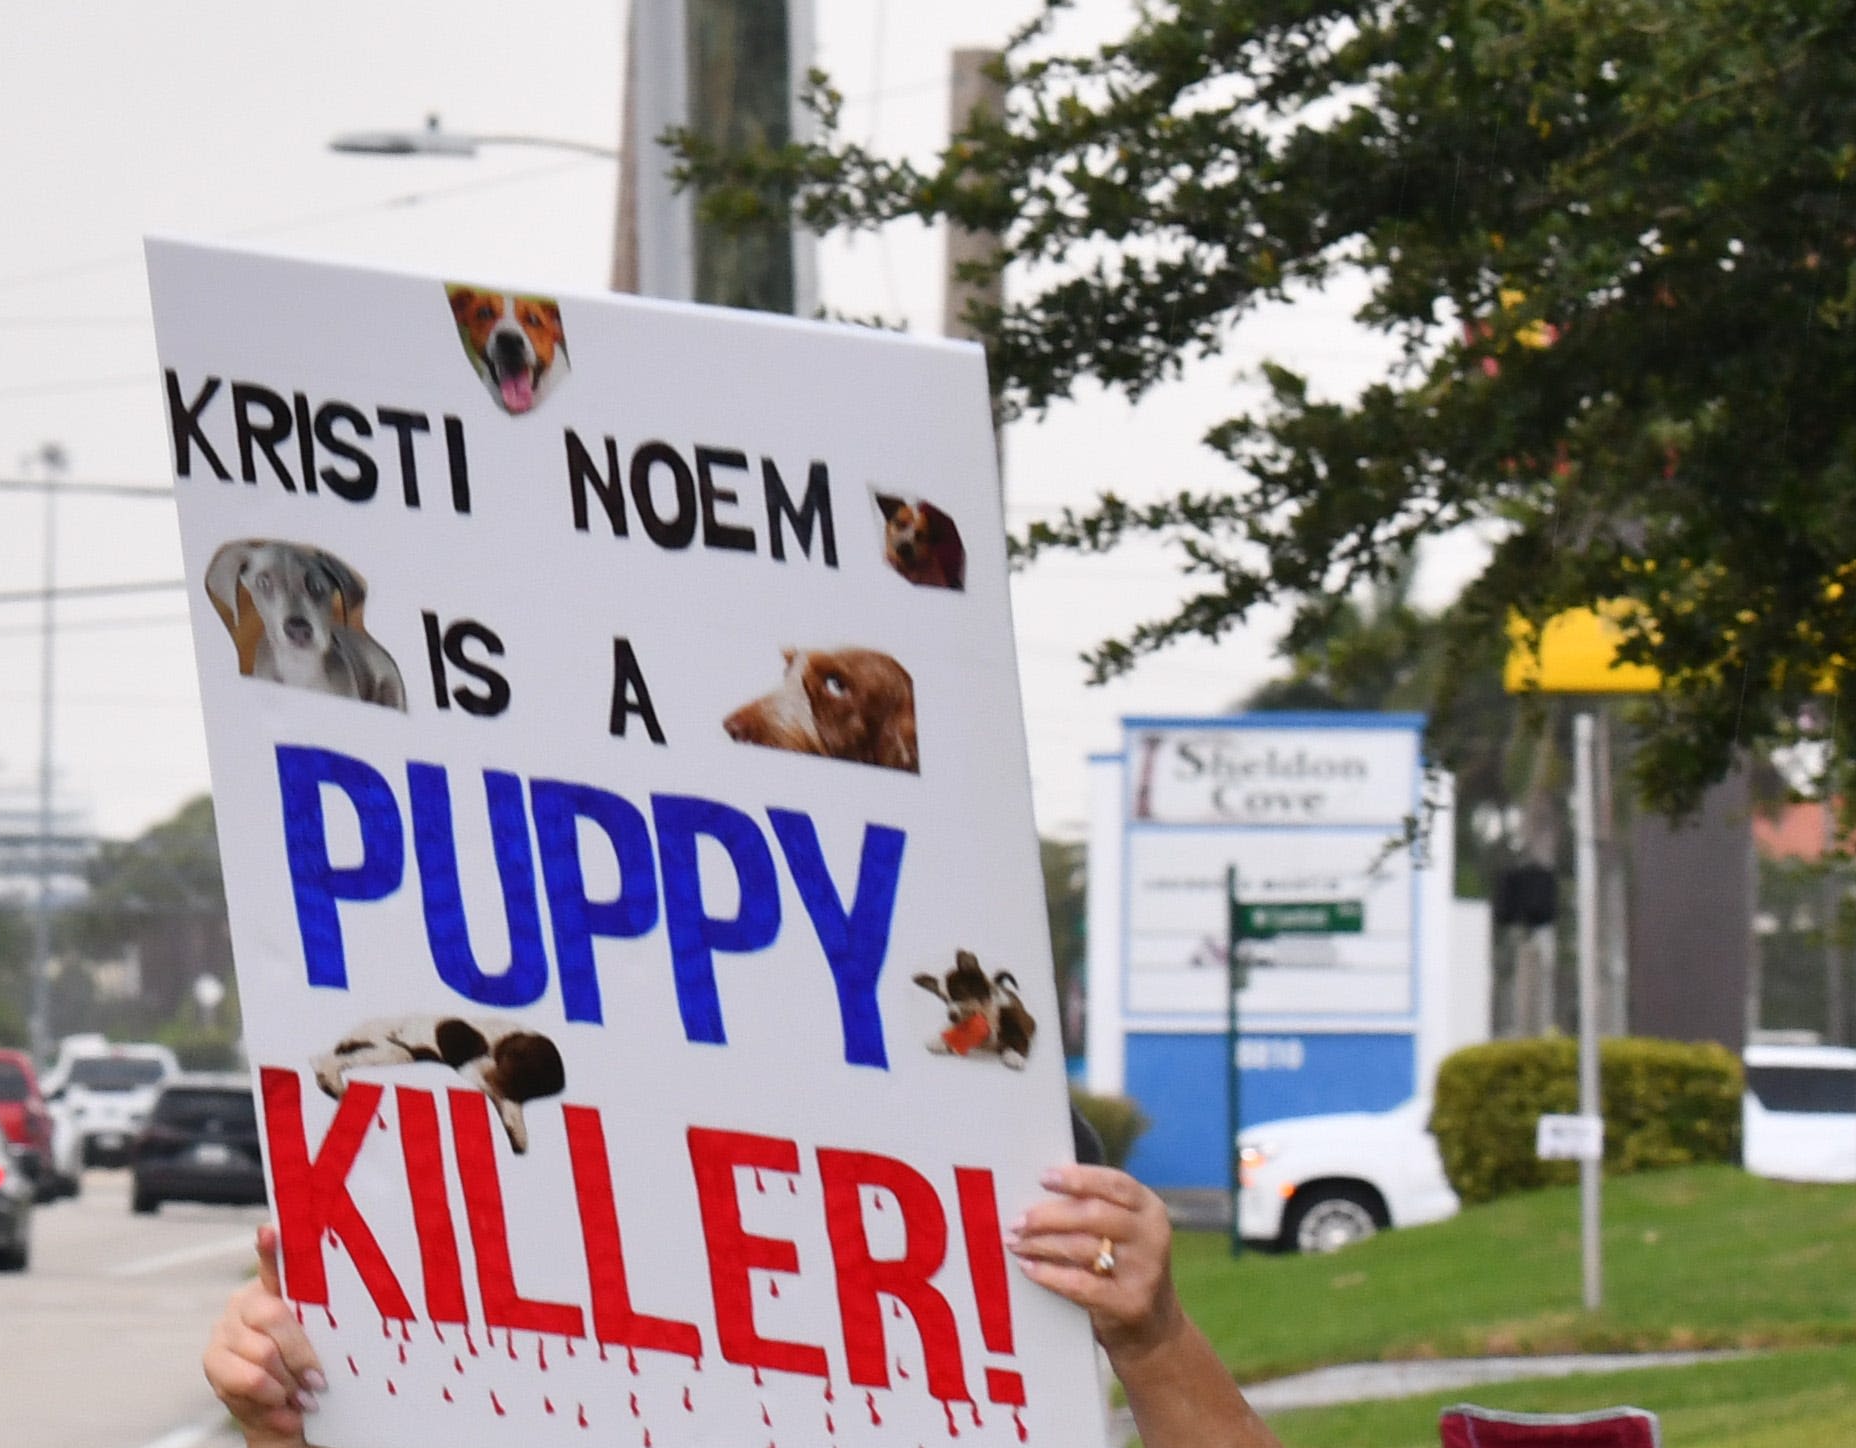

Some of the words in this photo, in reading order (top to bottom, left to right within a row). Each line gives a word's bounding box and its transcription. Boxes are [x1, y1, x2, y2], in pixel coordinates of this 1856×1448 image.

[164, 368, 471, 515] KRISTI
[563, 428, 840, 568] NOEM
[421, 609, 513, 717] IS
[609, 636, 668, 745] A
[1174, 742, 1369, 783] Sheldon
[1211, 782, 1328, 820] Cove
[273, 744, 908, 1071] PUPPY
[259, 1065, 1028, 1407] KILLER!
